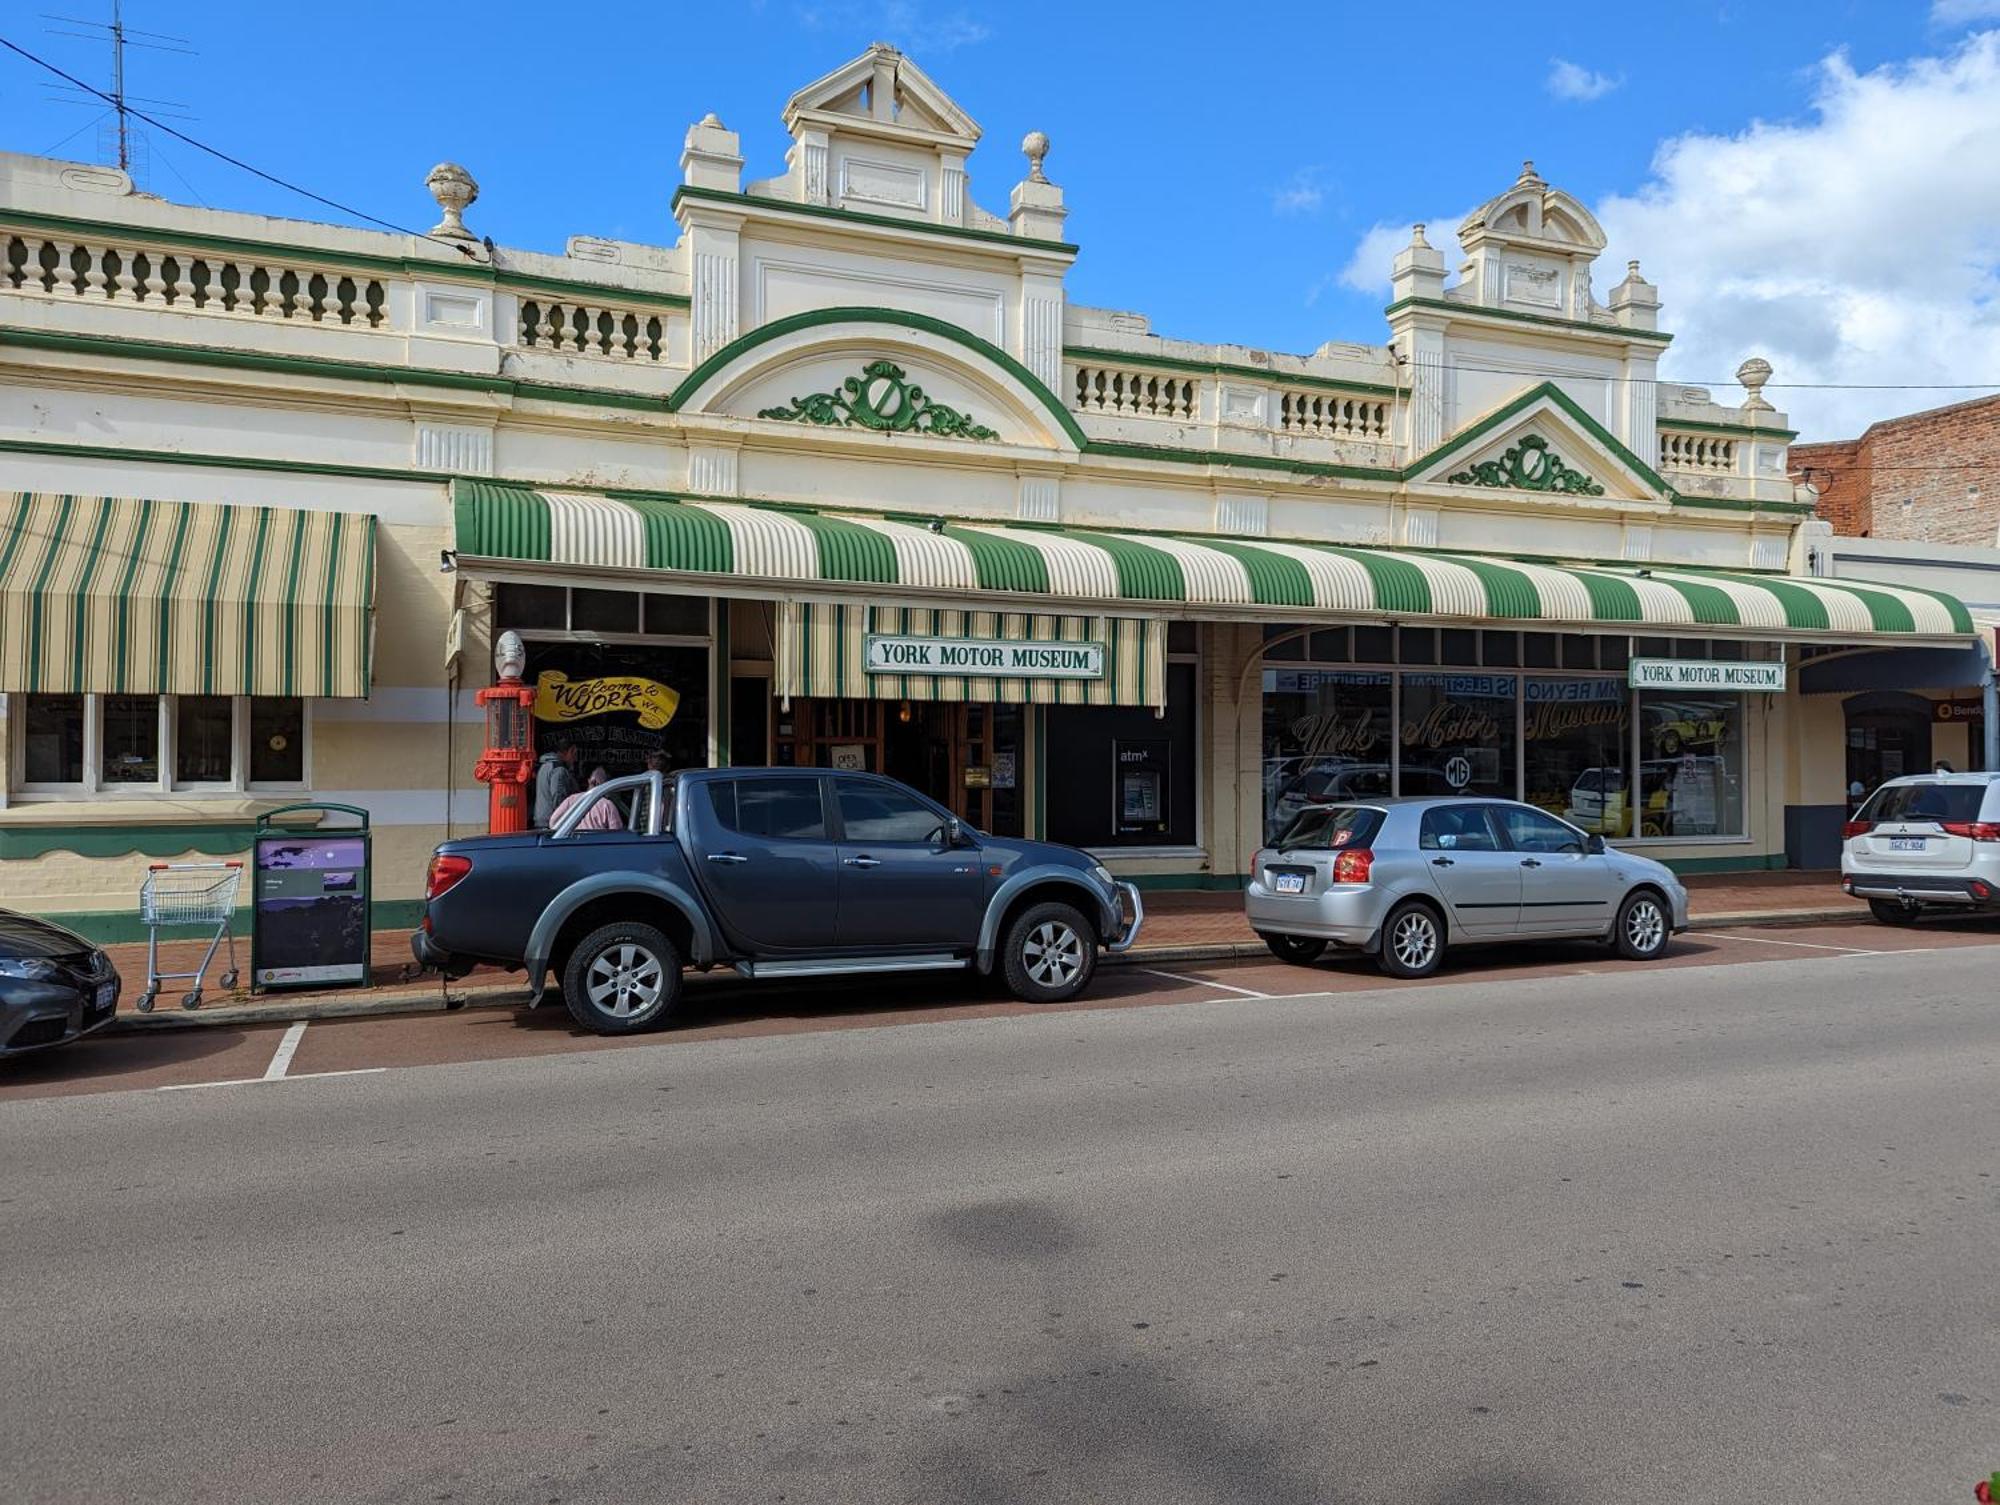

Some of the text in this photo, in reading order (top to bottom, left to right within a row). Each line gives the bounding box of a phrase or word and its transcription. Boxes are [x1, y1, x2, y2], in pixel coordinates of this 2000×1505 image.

[881, 643, 1090, 669] YORK MOTOR MUSEUM
[1641, 665, 1777, 685] YORK MOTOR MUSEUM
[550, 680, 660, 708] Welcome to
[1401, 701, 1499, 749] Motor
[1448, 759, 1469, 785] MG
